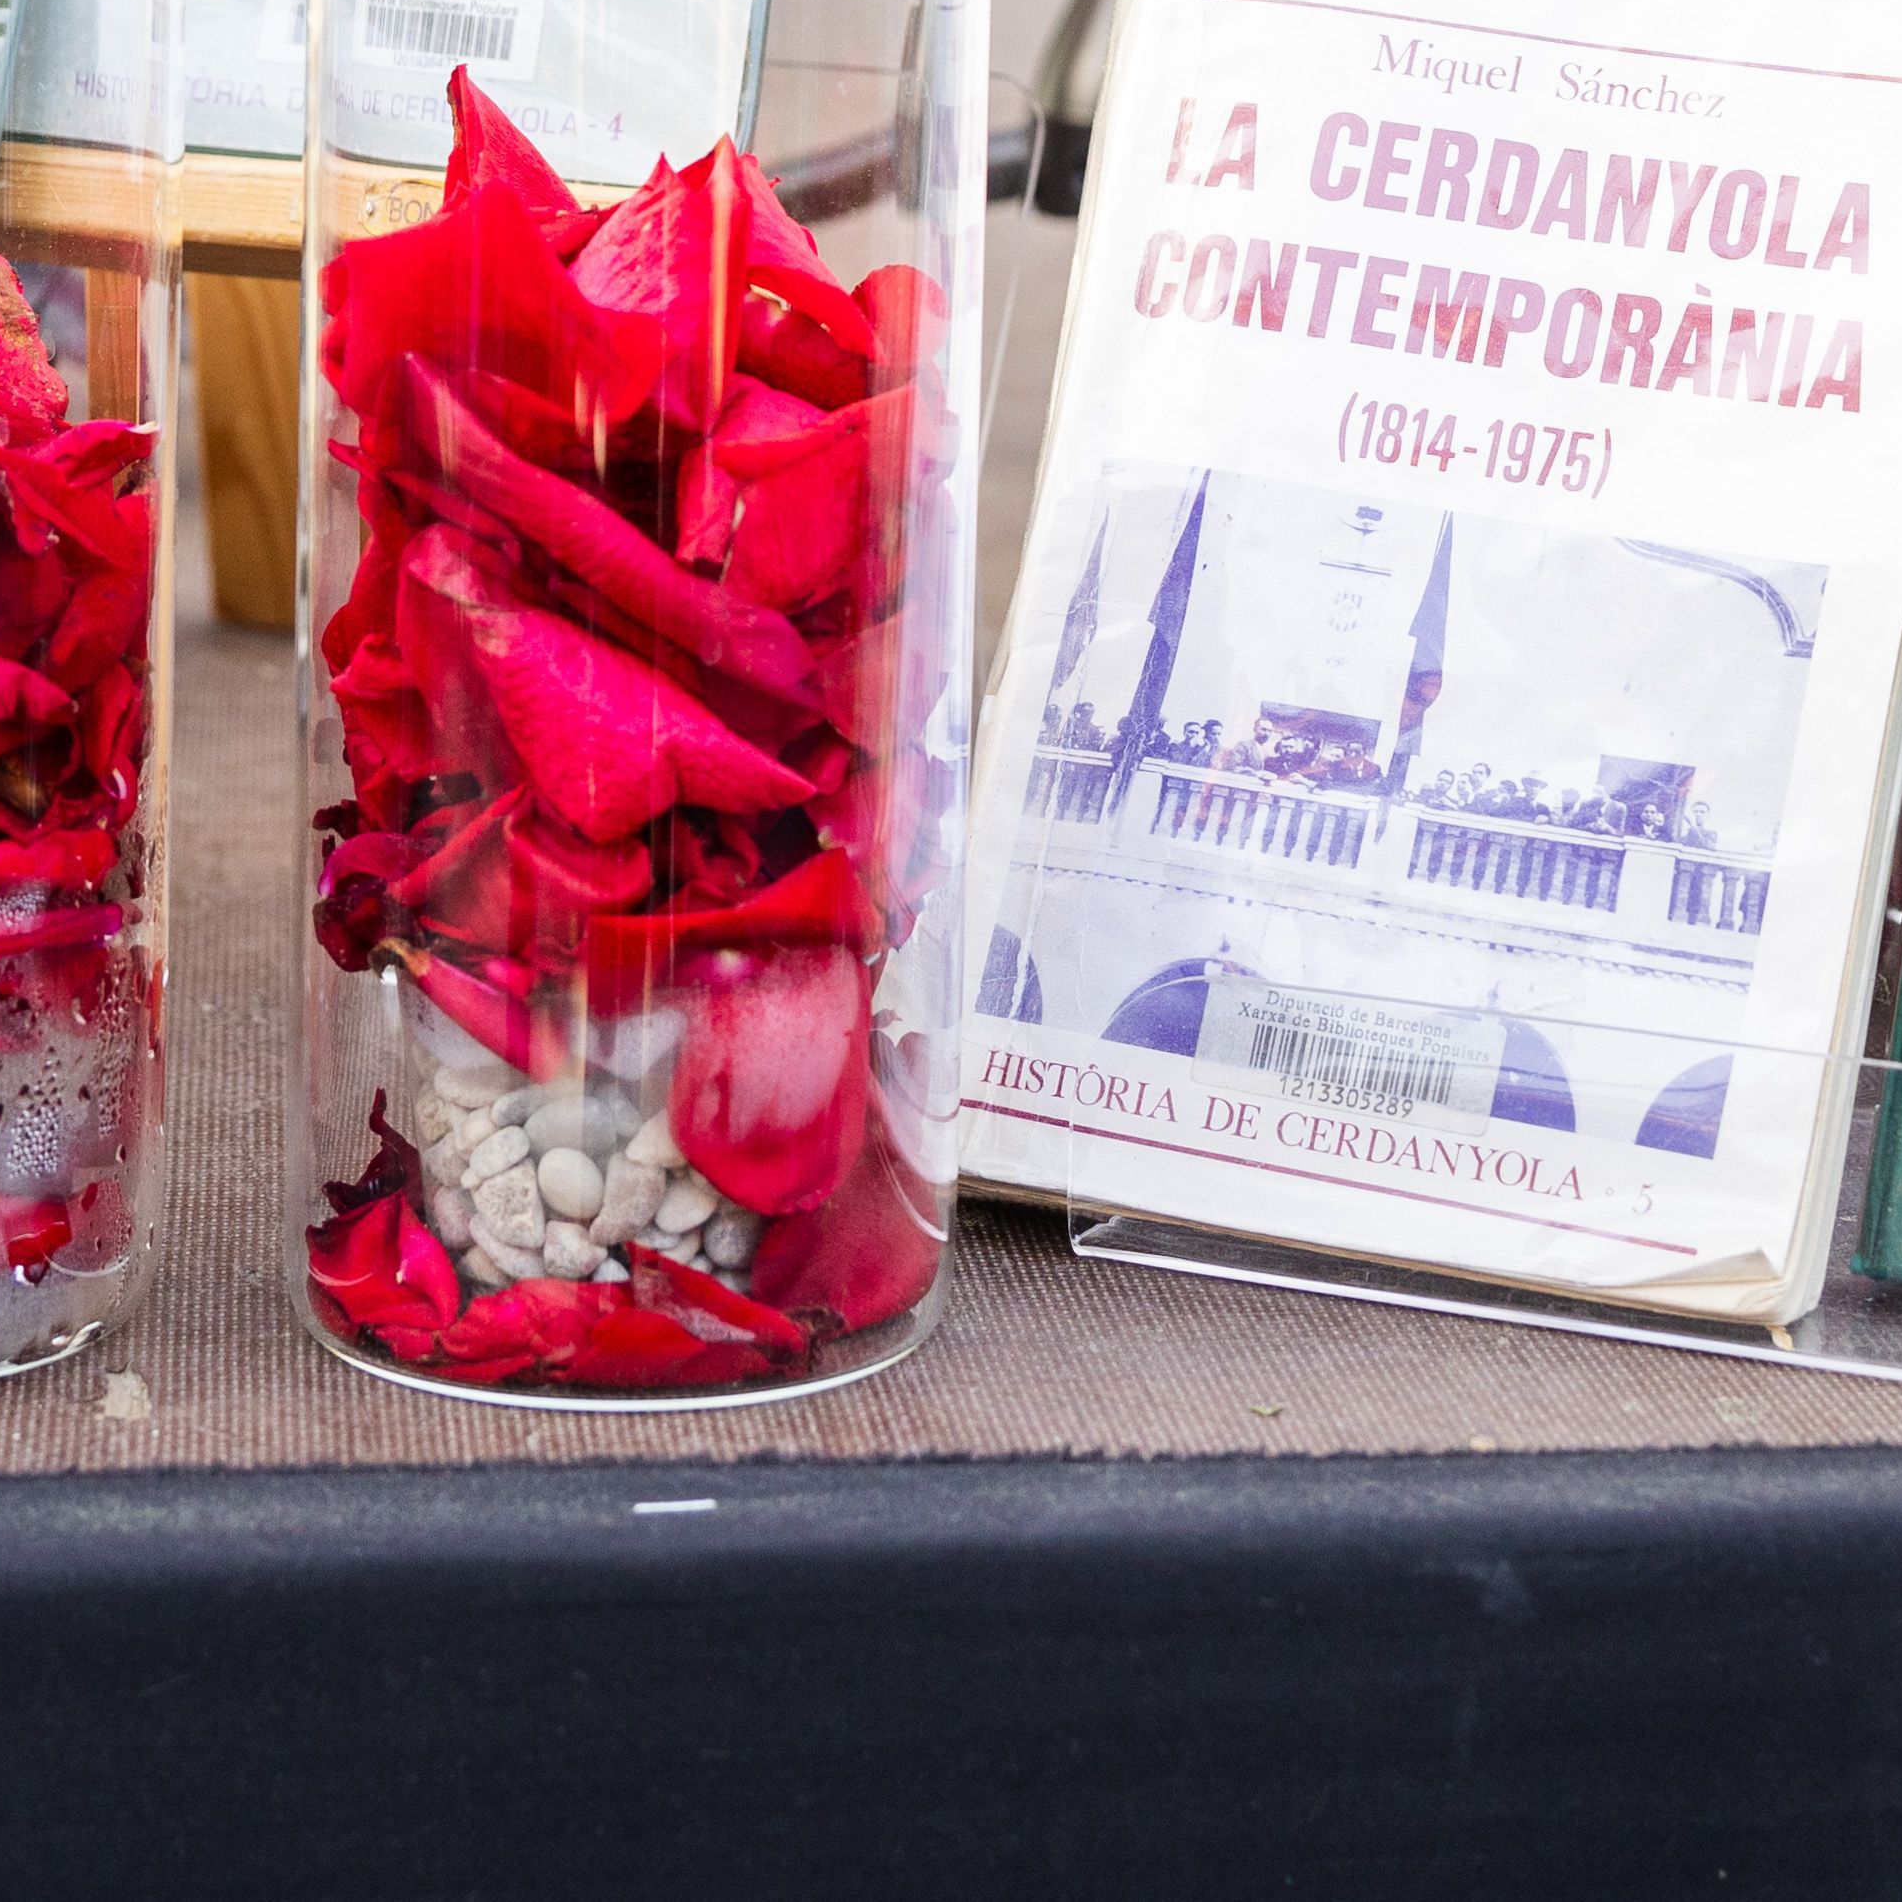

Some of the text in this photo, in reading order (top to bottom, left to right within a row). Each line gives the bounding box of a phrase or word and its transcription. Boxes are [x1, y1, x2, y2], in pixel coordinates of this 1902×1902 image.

[1372, 33, 1728, 120] Miquel Sánchez
[606, 112, 625, 141] 4
[1164, 97, 1872, 276] LA CERDANYOLA
[1132, 228, 1864, 414] CONTEMPORÀNIA
[1337, 391, 1613, 500] (1814-1975)
[1238, 1001, 1490, 1064] Xarxa de Biblioteques Populars
[1265, 990, 1452, 1038] Diputació de Barcelona
[1278, 1075, 1415, 1119] 1213305289
[1200, 1093, 1262, 1141] DE
[1276, 1110, 1585, 1202] CERDANYOLA
